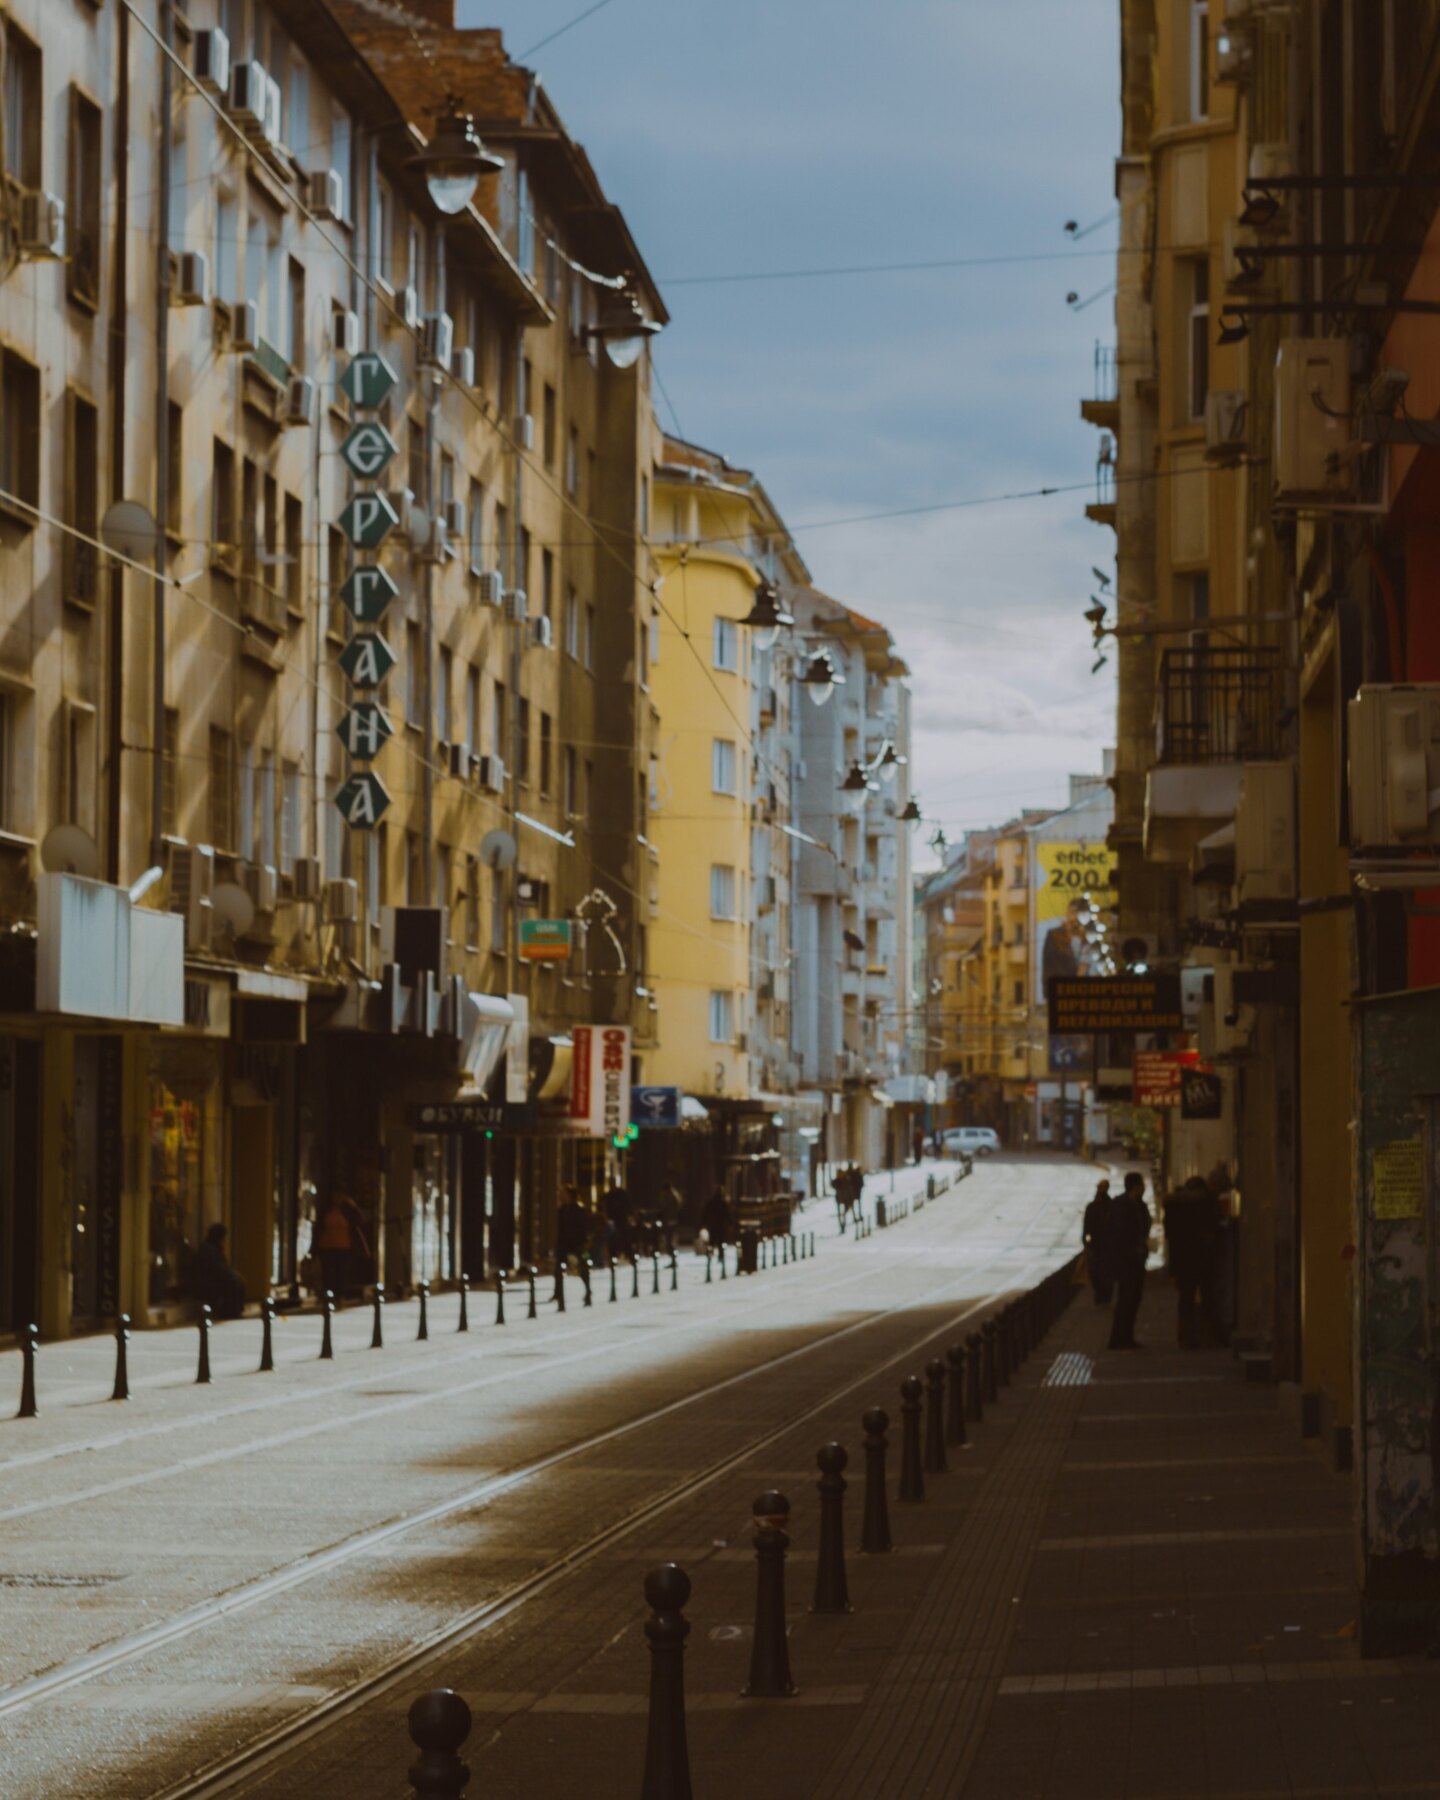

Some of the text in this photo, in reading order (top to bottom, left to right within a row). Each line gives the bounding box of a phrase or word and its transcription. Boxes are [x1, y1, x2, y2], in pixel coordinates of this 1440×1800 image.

[346, 357, 387, 825] ГЕРГАНА
[1056, 850, 1107, 865] efbet
[1056, 982, 1157, 995] ЕКСПРЕСНИ
[1056, 998, 1153, 1012] ПРЕВОДИ И
[1056, 1013, 1181, 1028] ЛЕГАЛИЗАЦИЯ
[603, 1029, 624, 1071] GSM
